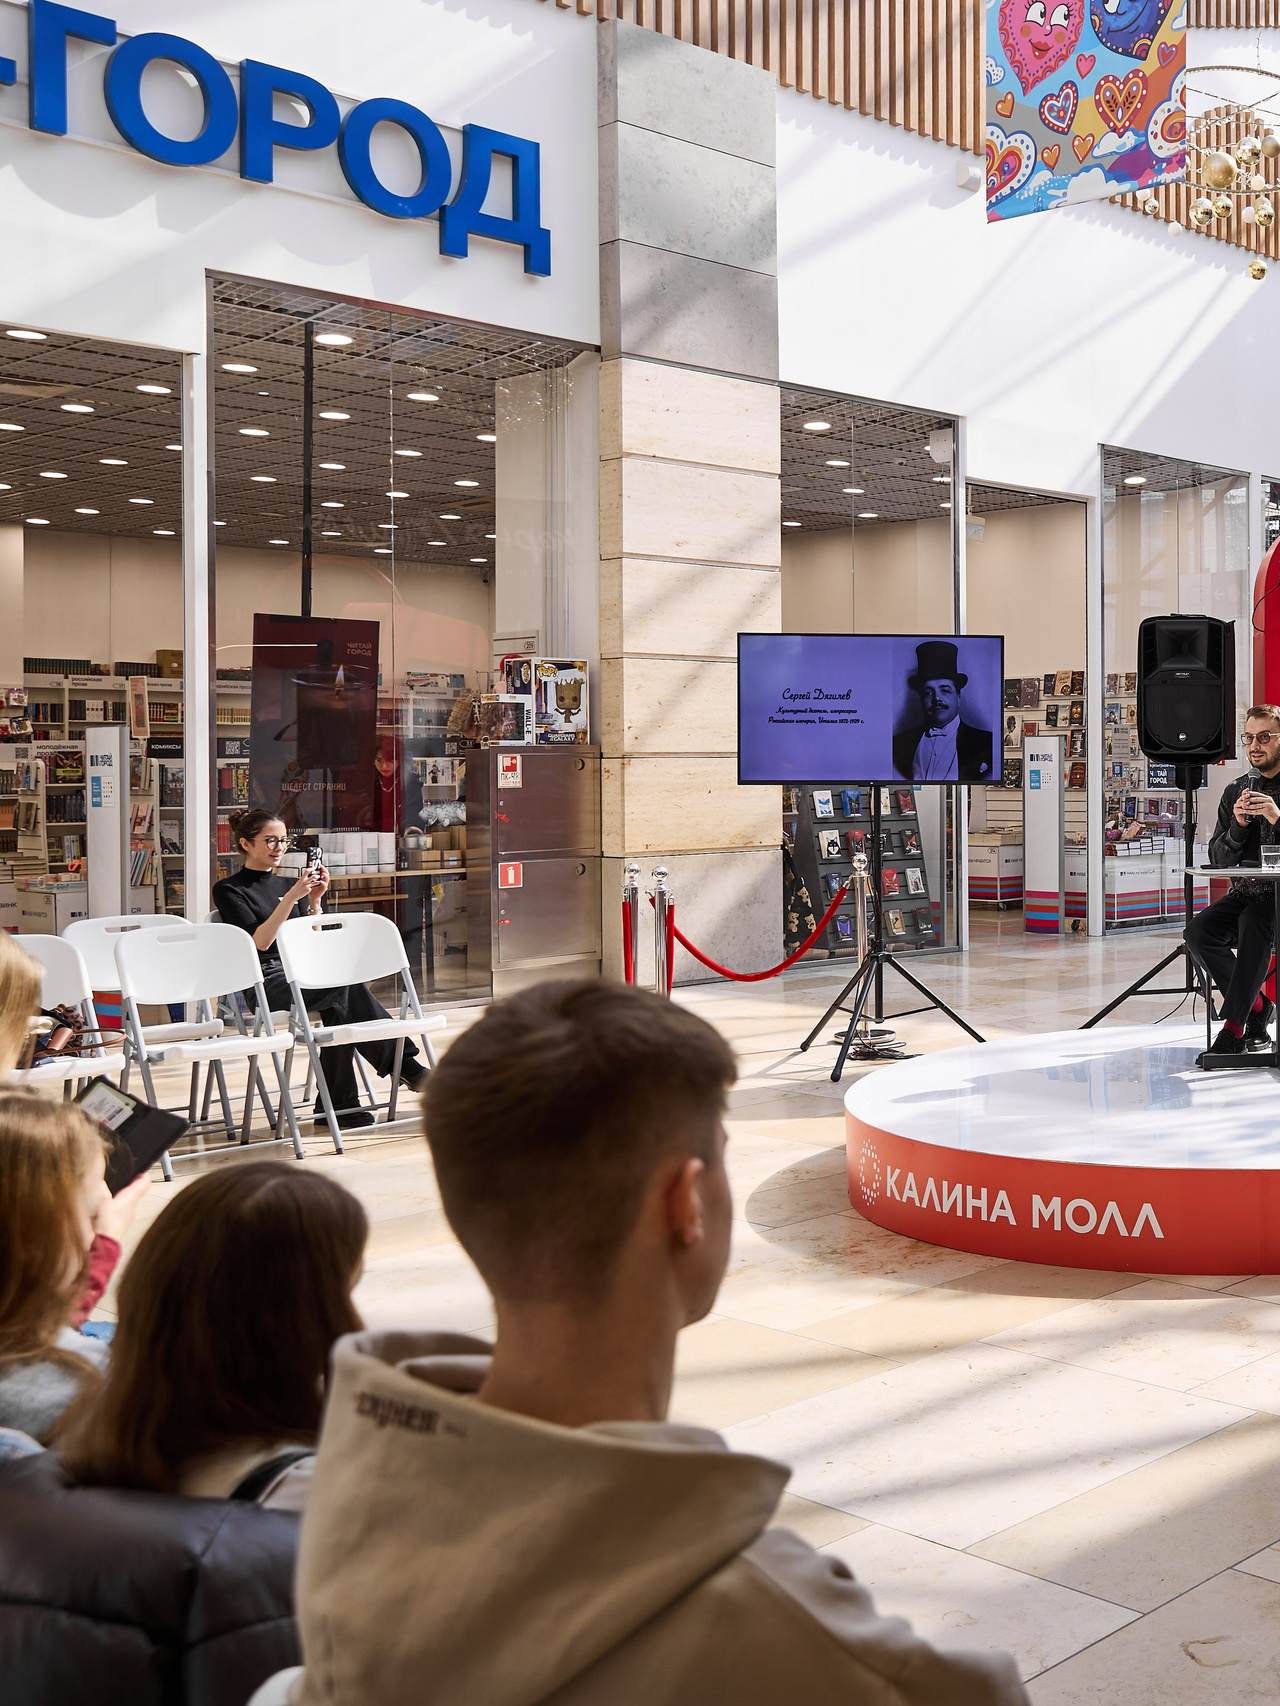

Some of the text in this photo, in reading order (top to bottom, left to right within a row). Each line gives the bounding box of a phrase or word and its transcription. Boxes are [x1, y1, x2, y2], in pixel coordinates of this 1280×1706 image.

[537, 665, 558, 678] POP!
[782, 688, 852, 702] Сергей Дягилев
[281, 782, 347, 791] ШЕЛЕСТ СТРАНИЦ
[885, 1164, 1165, 1239] КАЛИНА МОЛЛ
